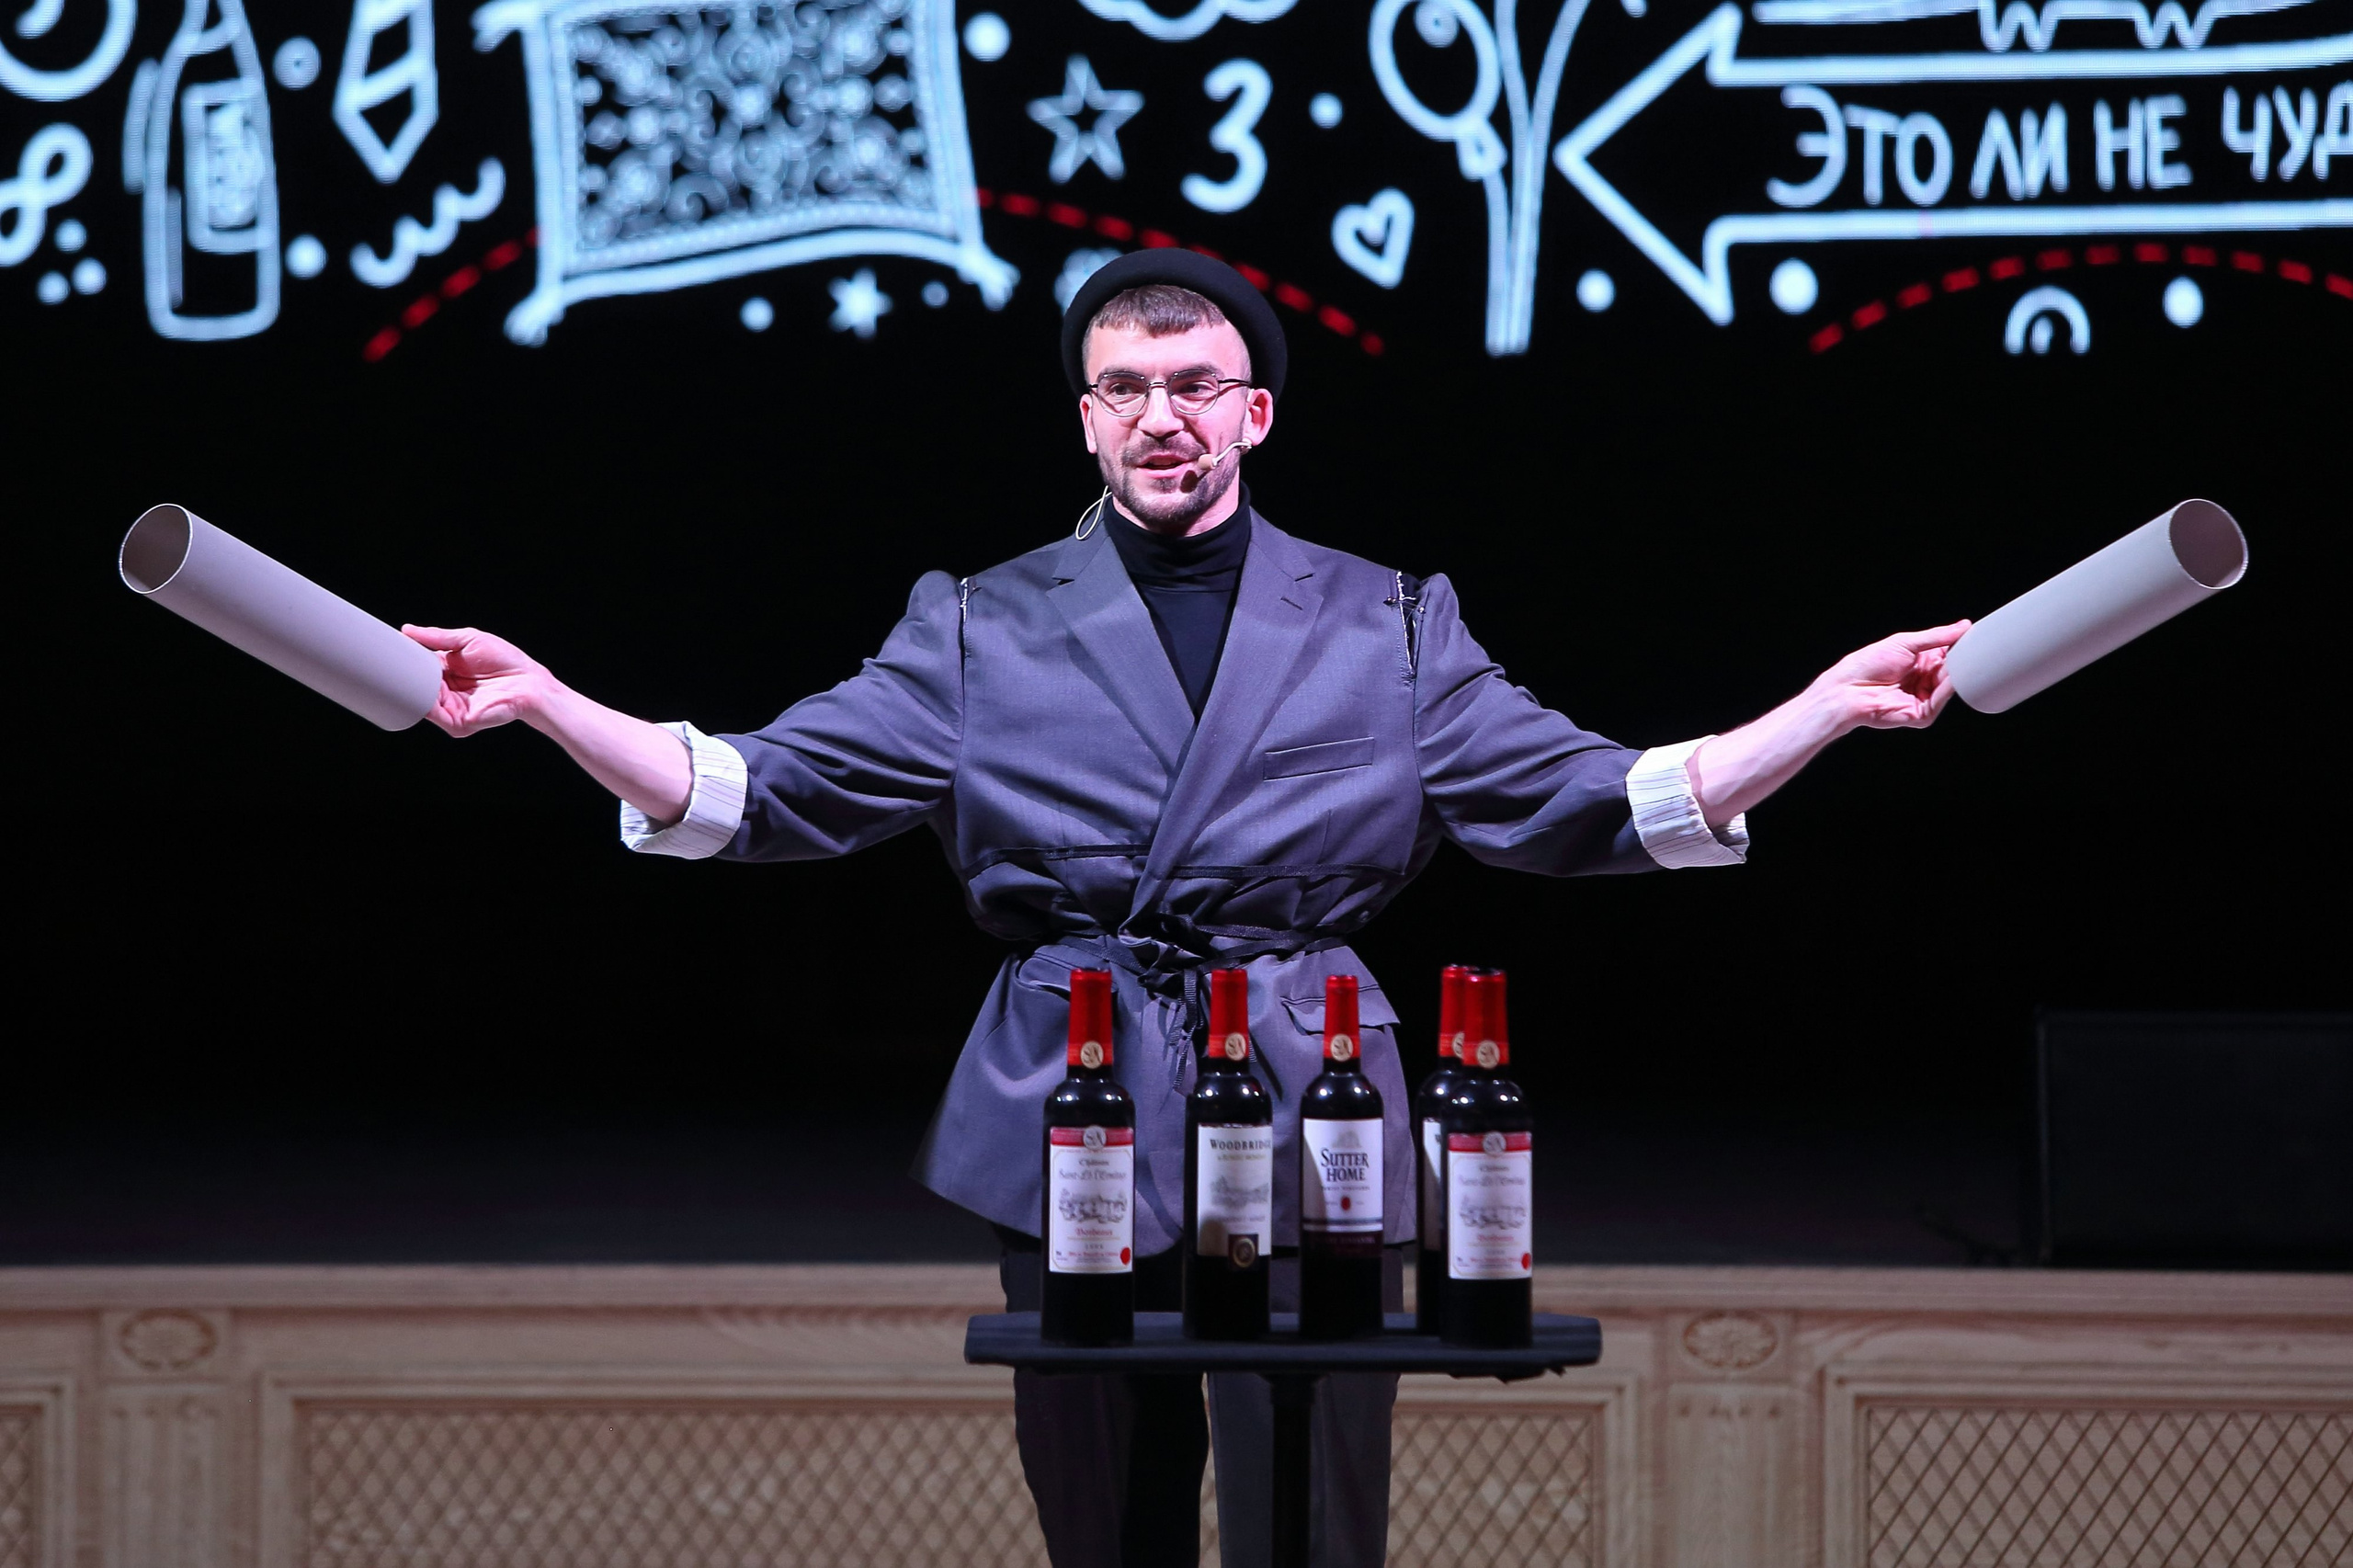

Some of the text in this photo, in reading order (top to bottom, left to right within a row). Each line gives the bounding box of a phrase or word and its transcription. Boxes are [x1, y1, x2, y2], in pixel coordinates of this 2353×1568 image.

[1181, 58, 1273, 214] 3
[1767, 84, 1953, 208] ЭТО
[1970, 103, 2068, 200] ЛИ
[2094, 95, 2193, 192] НЕ
[1326, 1167, 1366, 1182] HOME
